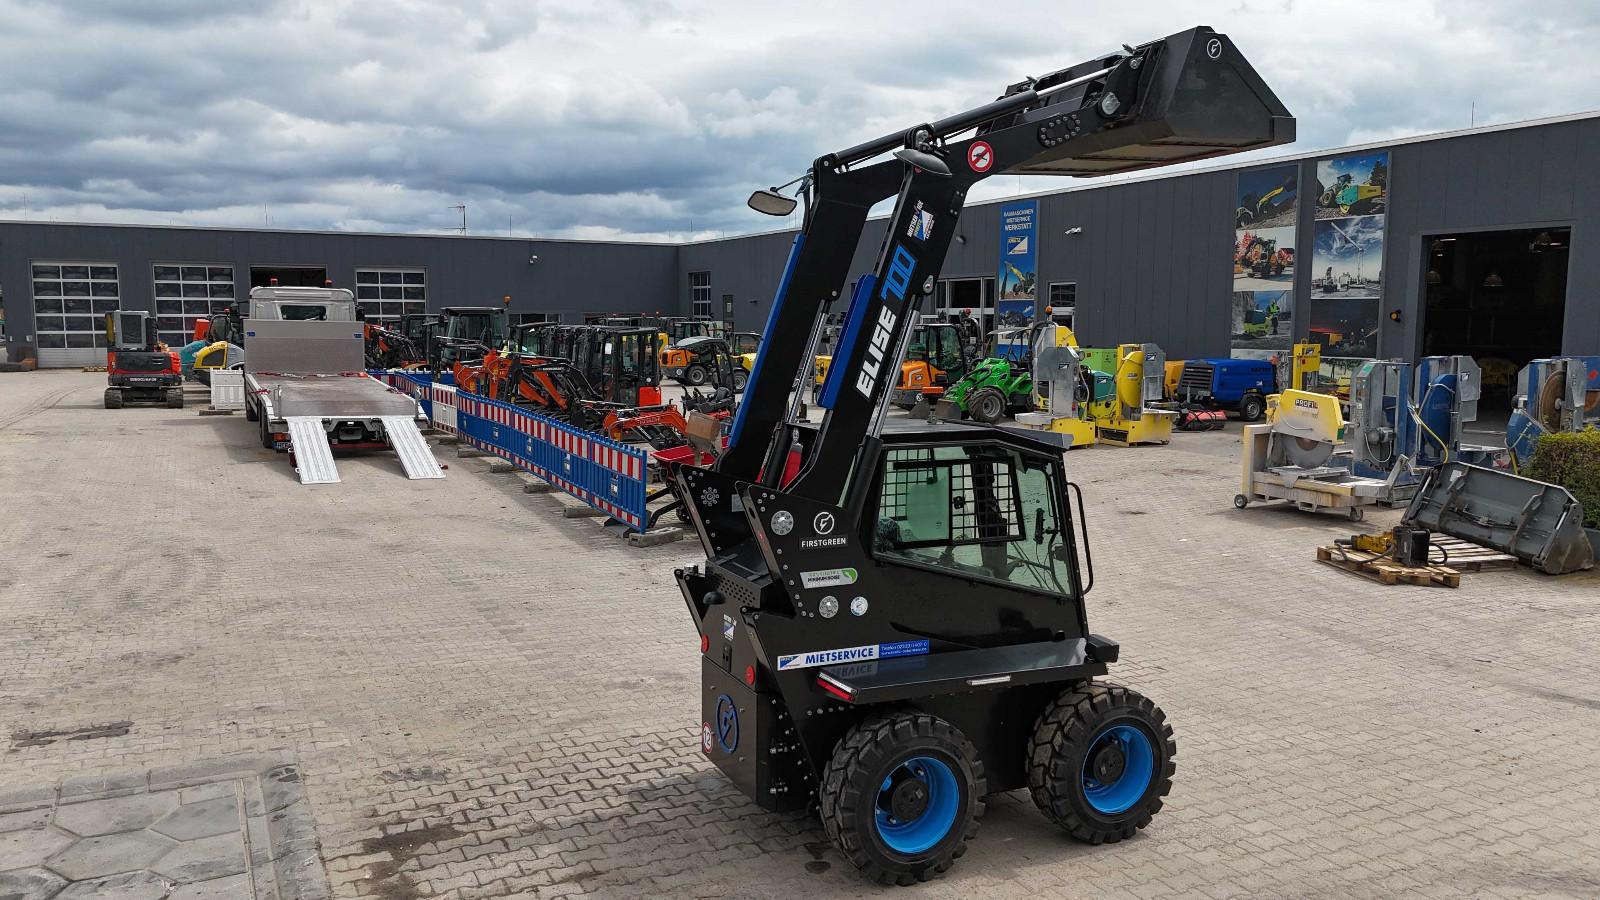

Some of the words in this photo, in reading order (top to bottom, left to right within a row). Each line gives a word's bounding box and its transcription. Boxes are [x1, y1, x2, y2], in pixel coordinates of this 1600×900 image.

[1005, 223, 1032, 231] WERKSTATT
[856, 305, 897, 398] ELISE
[880, 244, 917, 301] 700
[801, 537, 846, 548] FIRSTGREEN
[805, 647, 873, 665] MIETSERVICE
